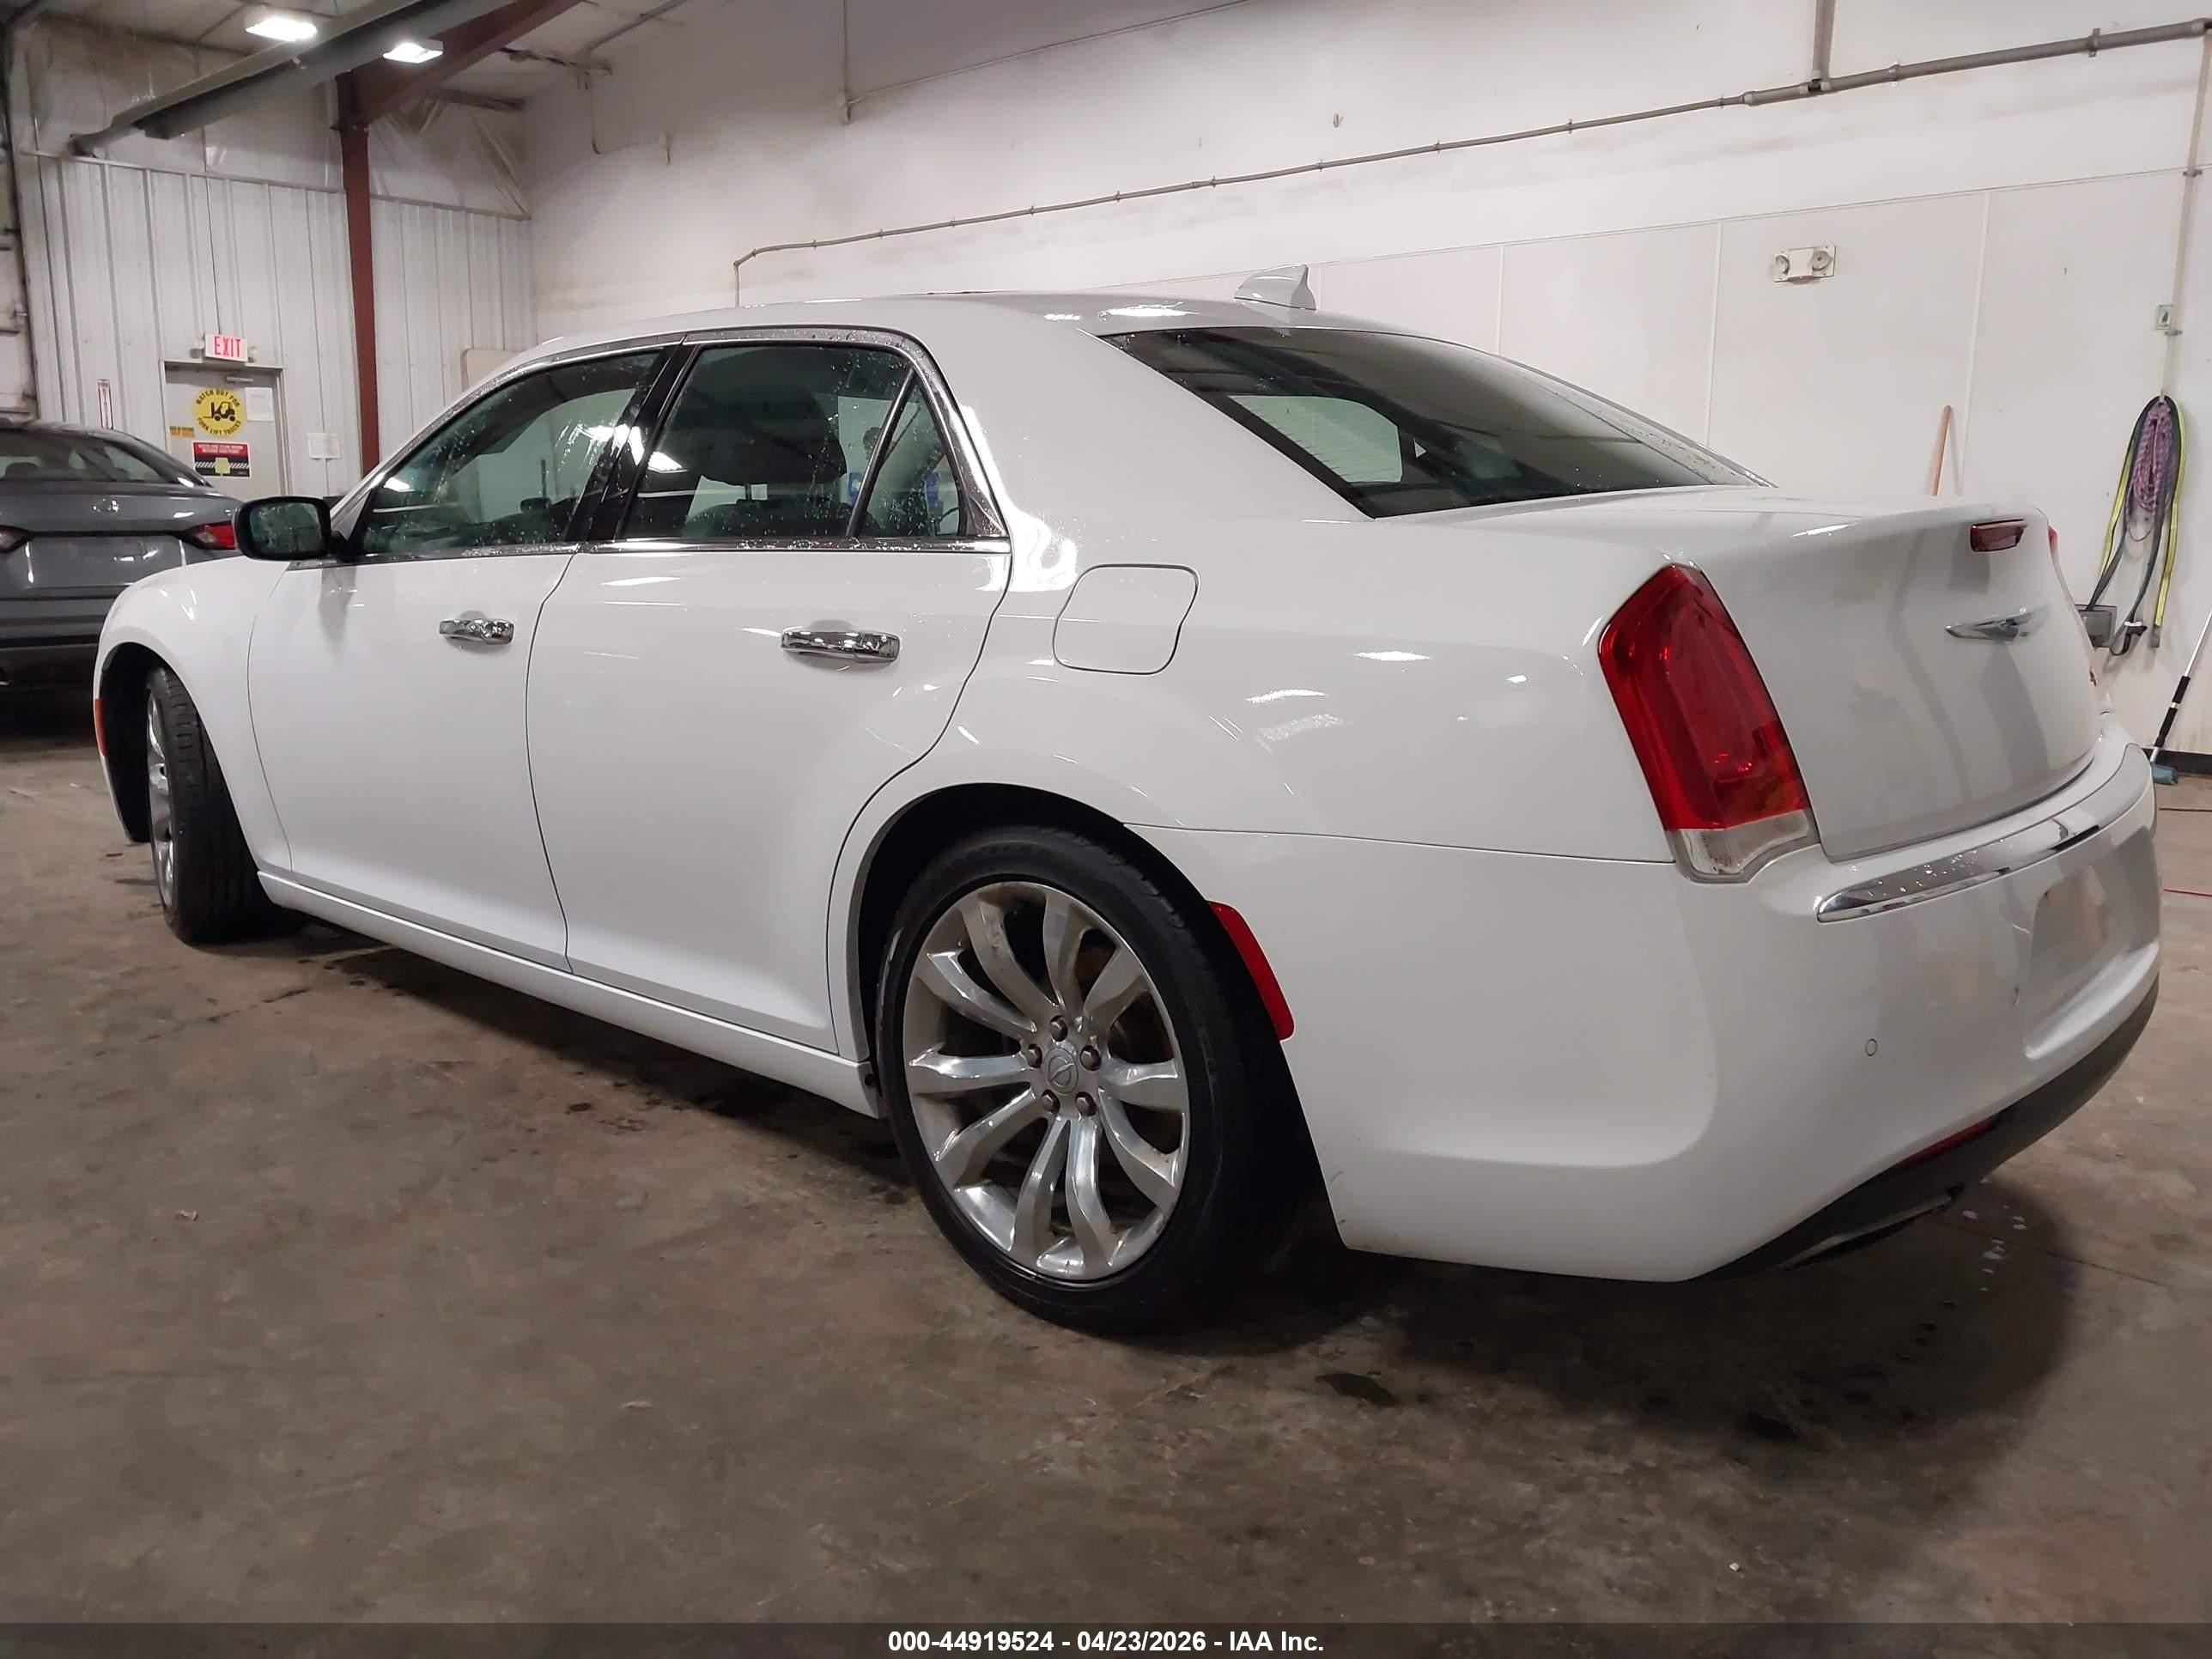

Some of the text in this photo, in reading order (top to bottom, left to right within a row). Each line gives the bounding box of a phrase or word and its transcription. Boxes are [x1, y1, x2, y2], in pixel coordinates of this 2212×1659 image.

[214, 336, 241, 358] EXIT
[196, 389, 215, 404] WATCH
[216, 388, 228, 397] OUT
[228, 395, 240, 407] FOR
